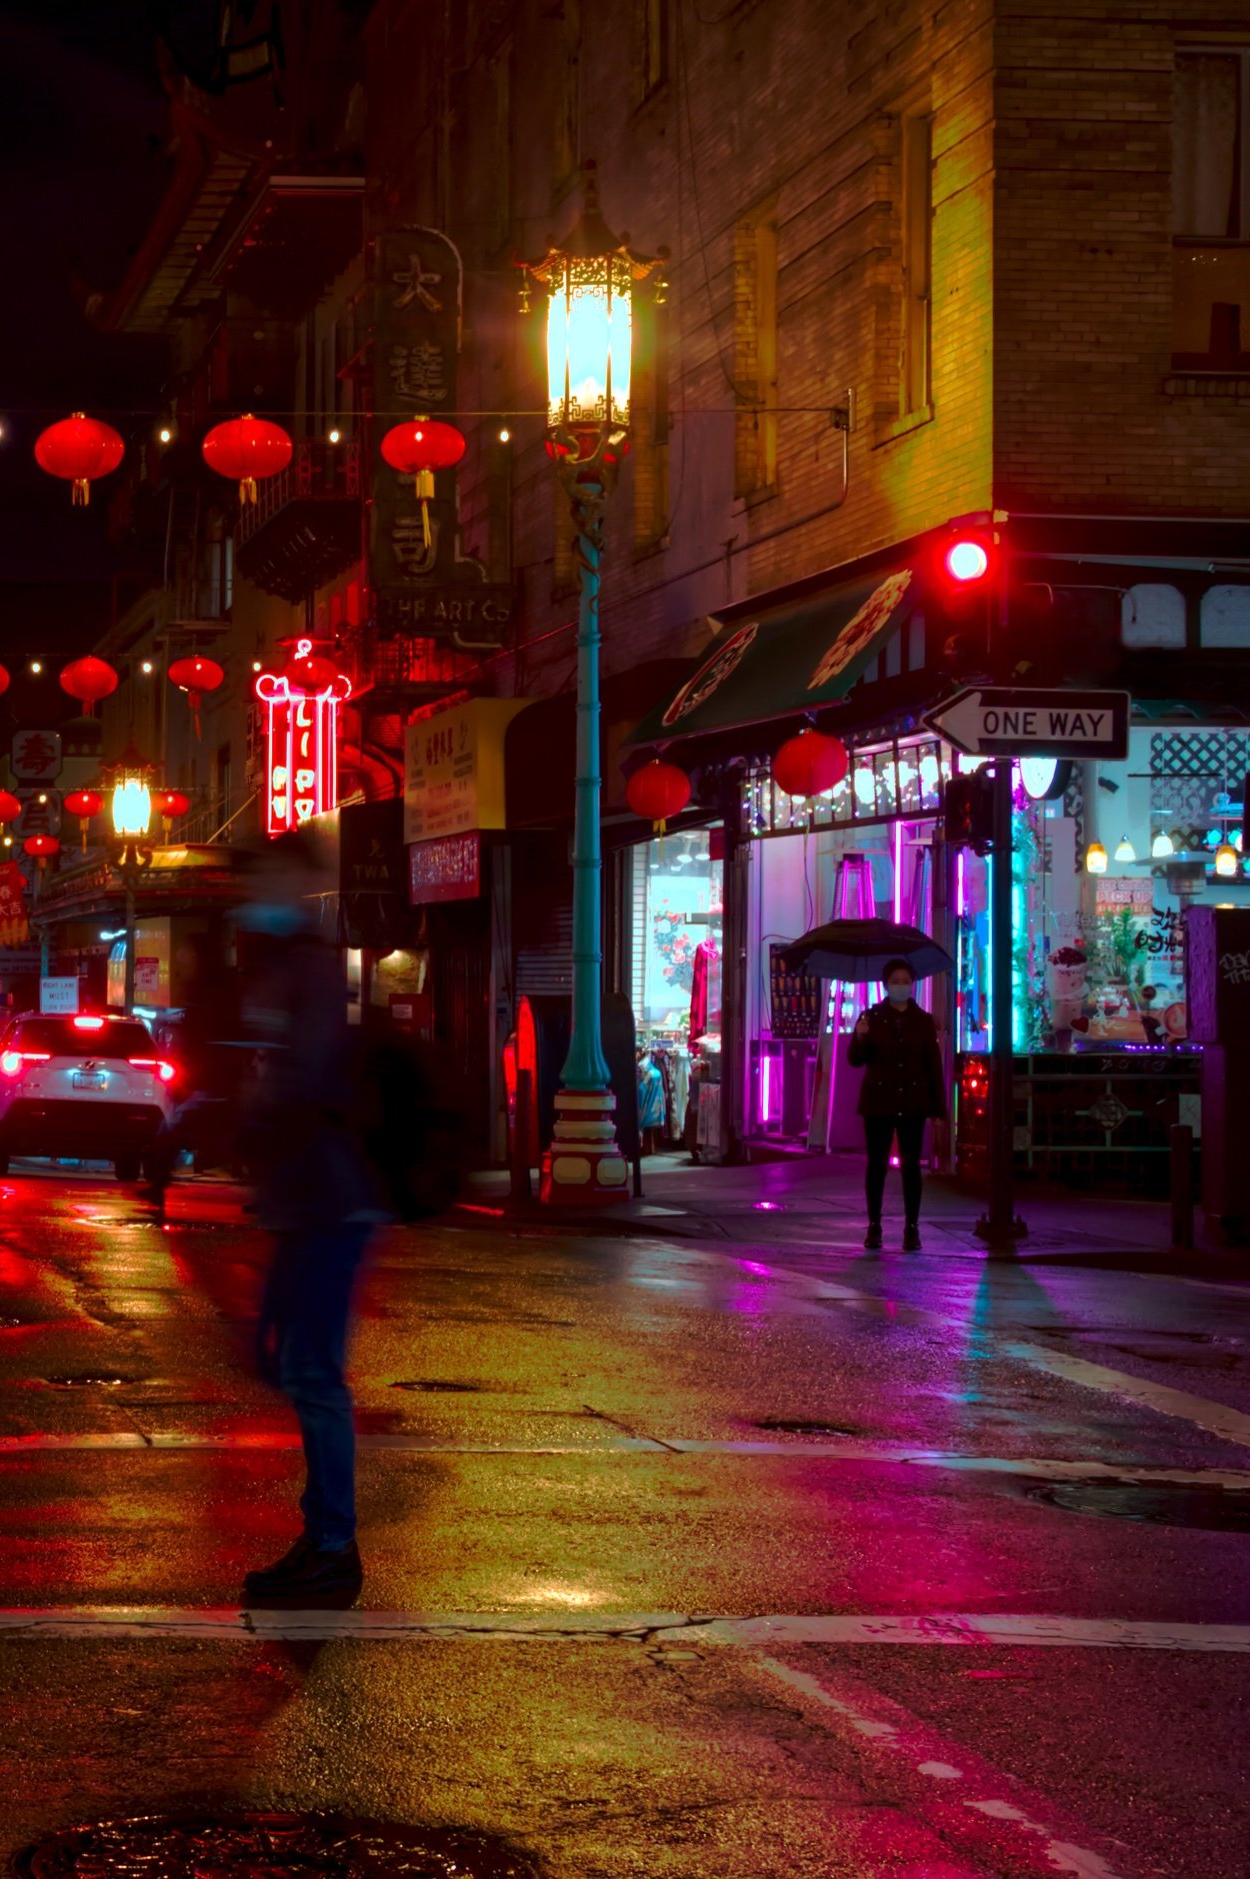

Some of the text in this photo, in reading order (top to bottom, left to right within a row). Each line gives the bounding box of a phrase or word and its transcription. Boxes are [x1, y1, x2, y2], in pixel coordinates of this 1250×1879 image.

[434, 600, 475, 622] ART
[983, 710, 1105, 737] ONE WAY
